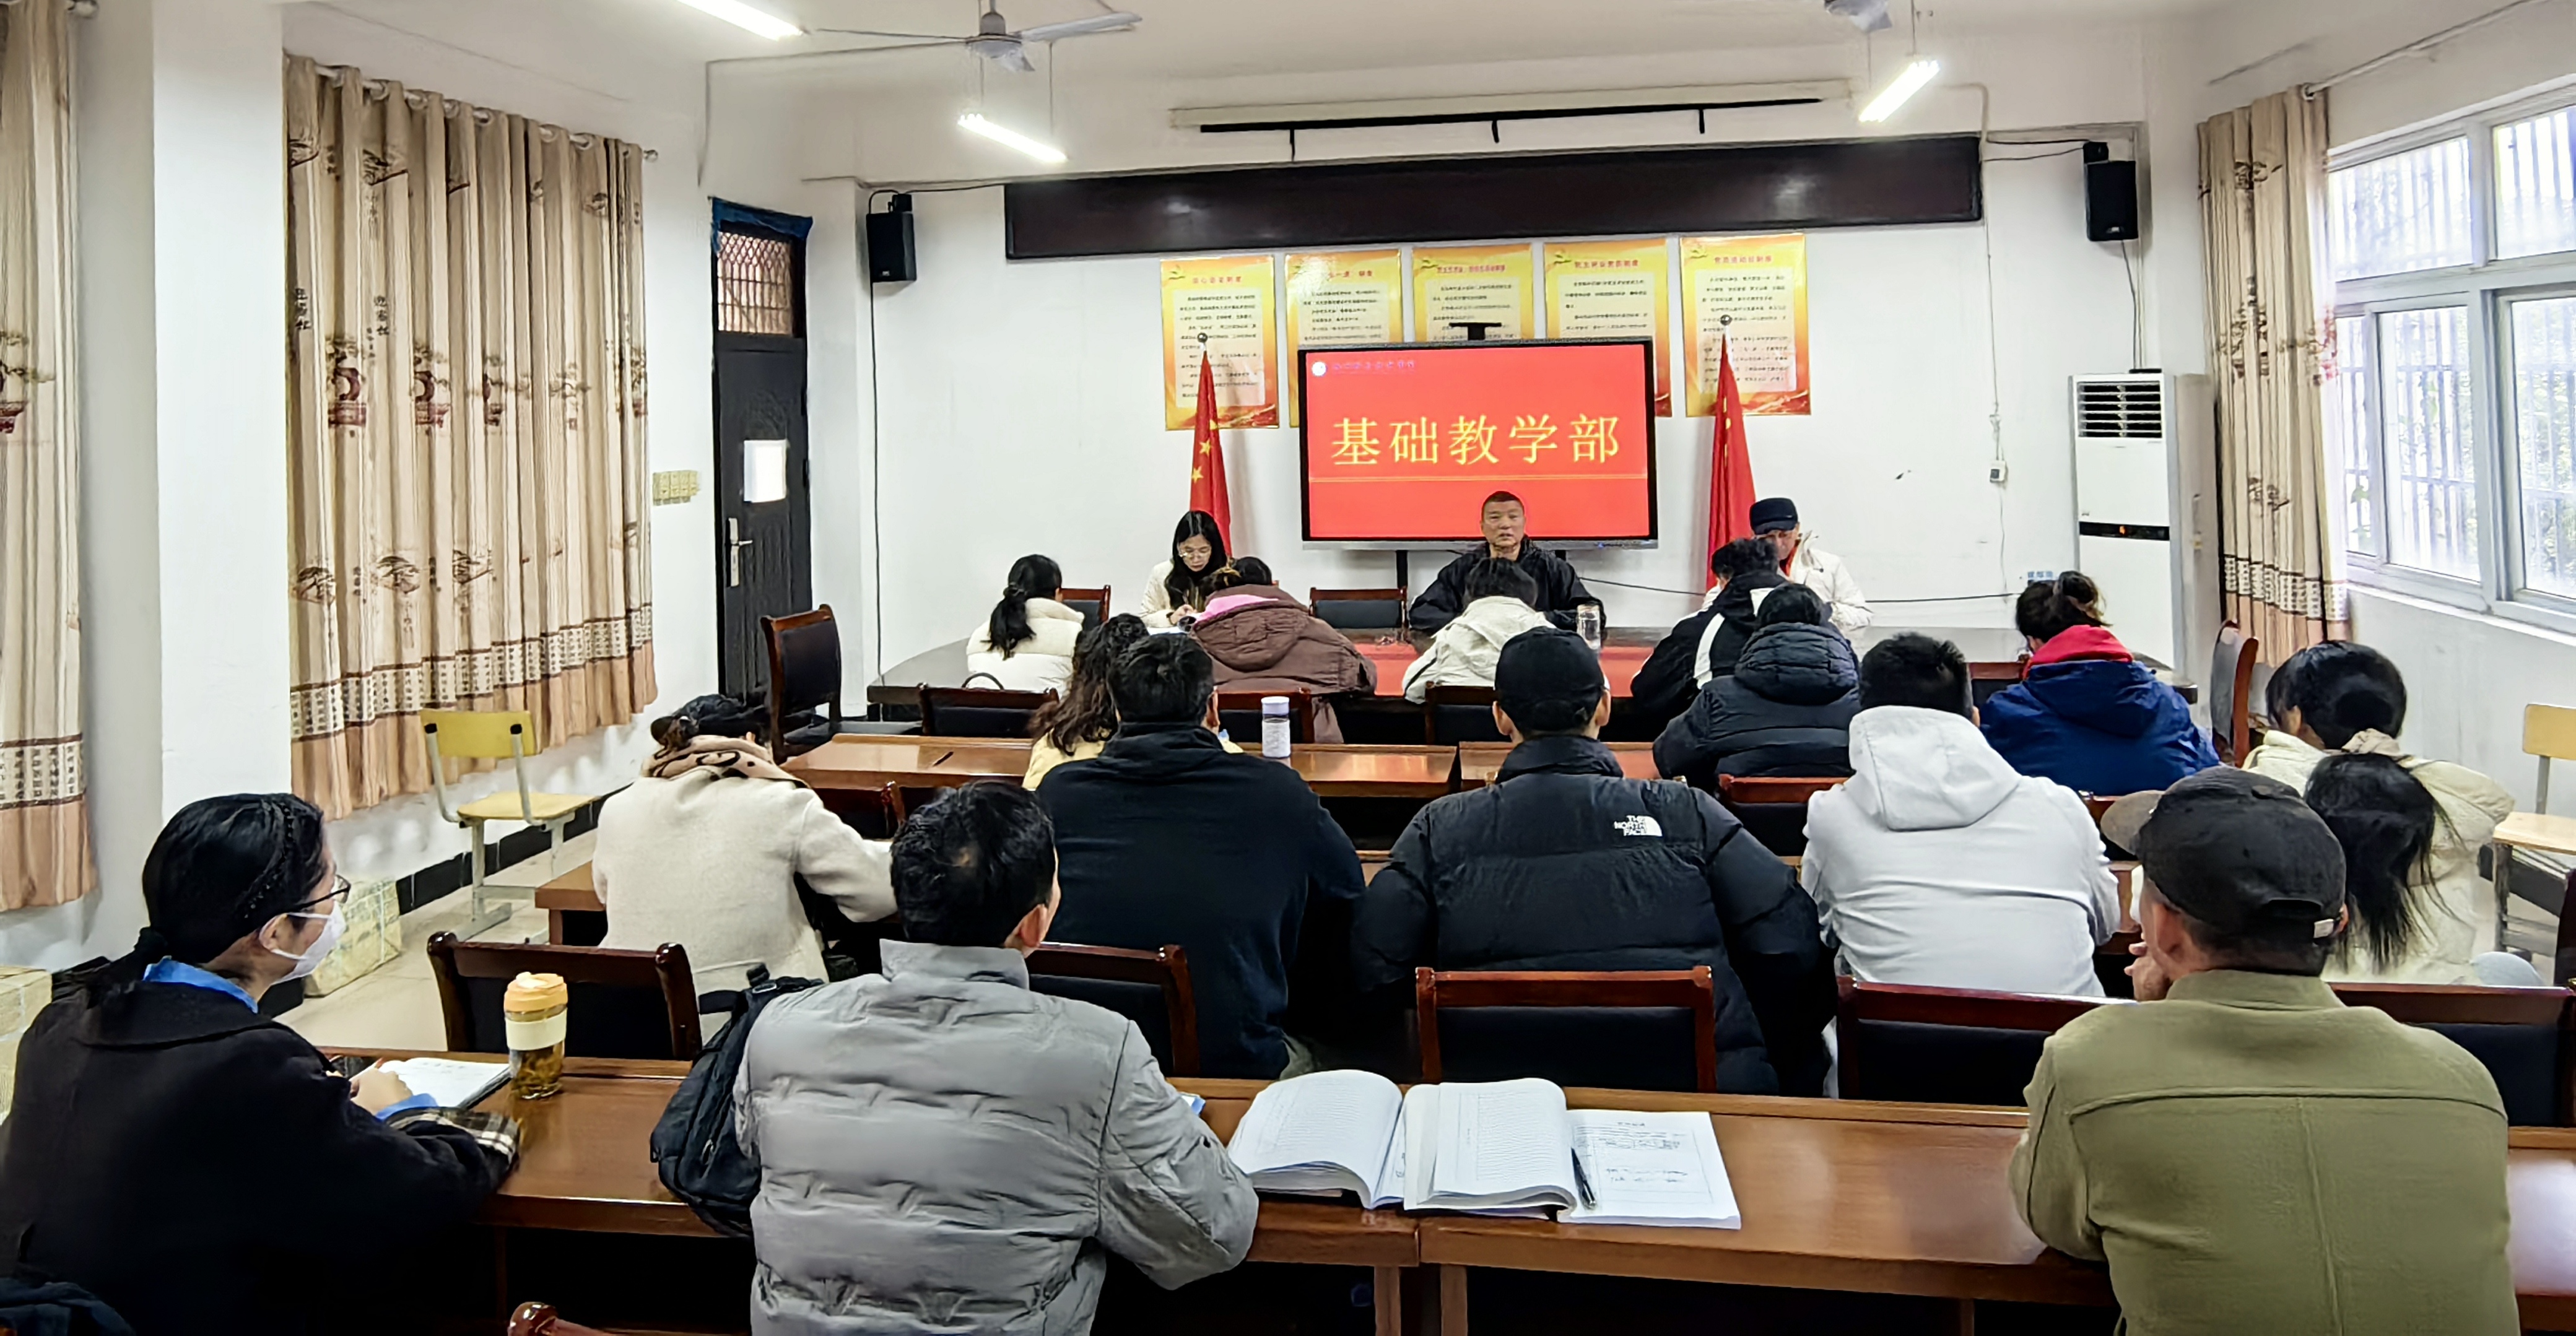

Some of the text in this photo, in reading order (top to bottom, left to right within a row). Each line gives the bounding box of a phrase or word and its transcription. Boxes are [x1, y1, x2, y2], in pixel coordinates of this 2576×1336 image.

[1331, 414, 1619, 465] 基础教学部
